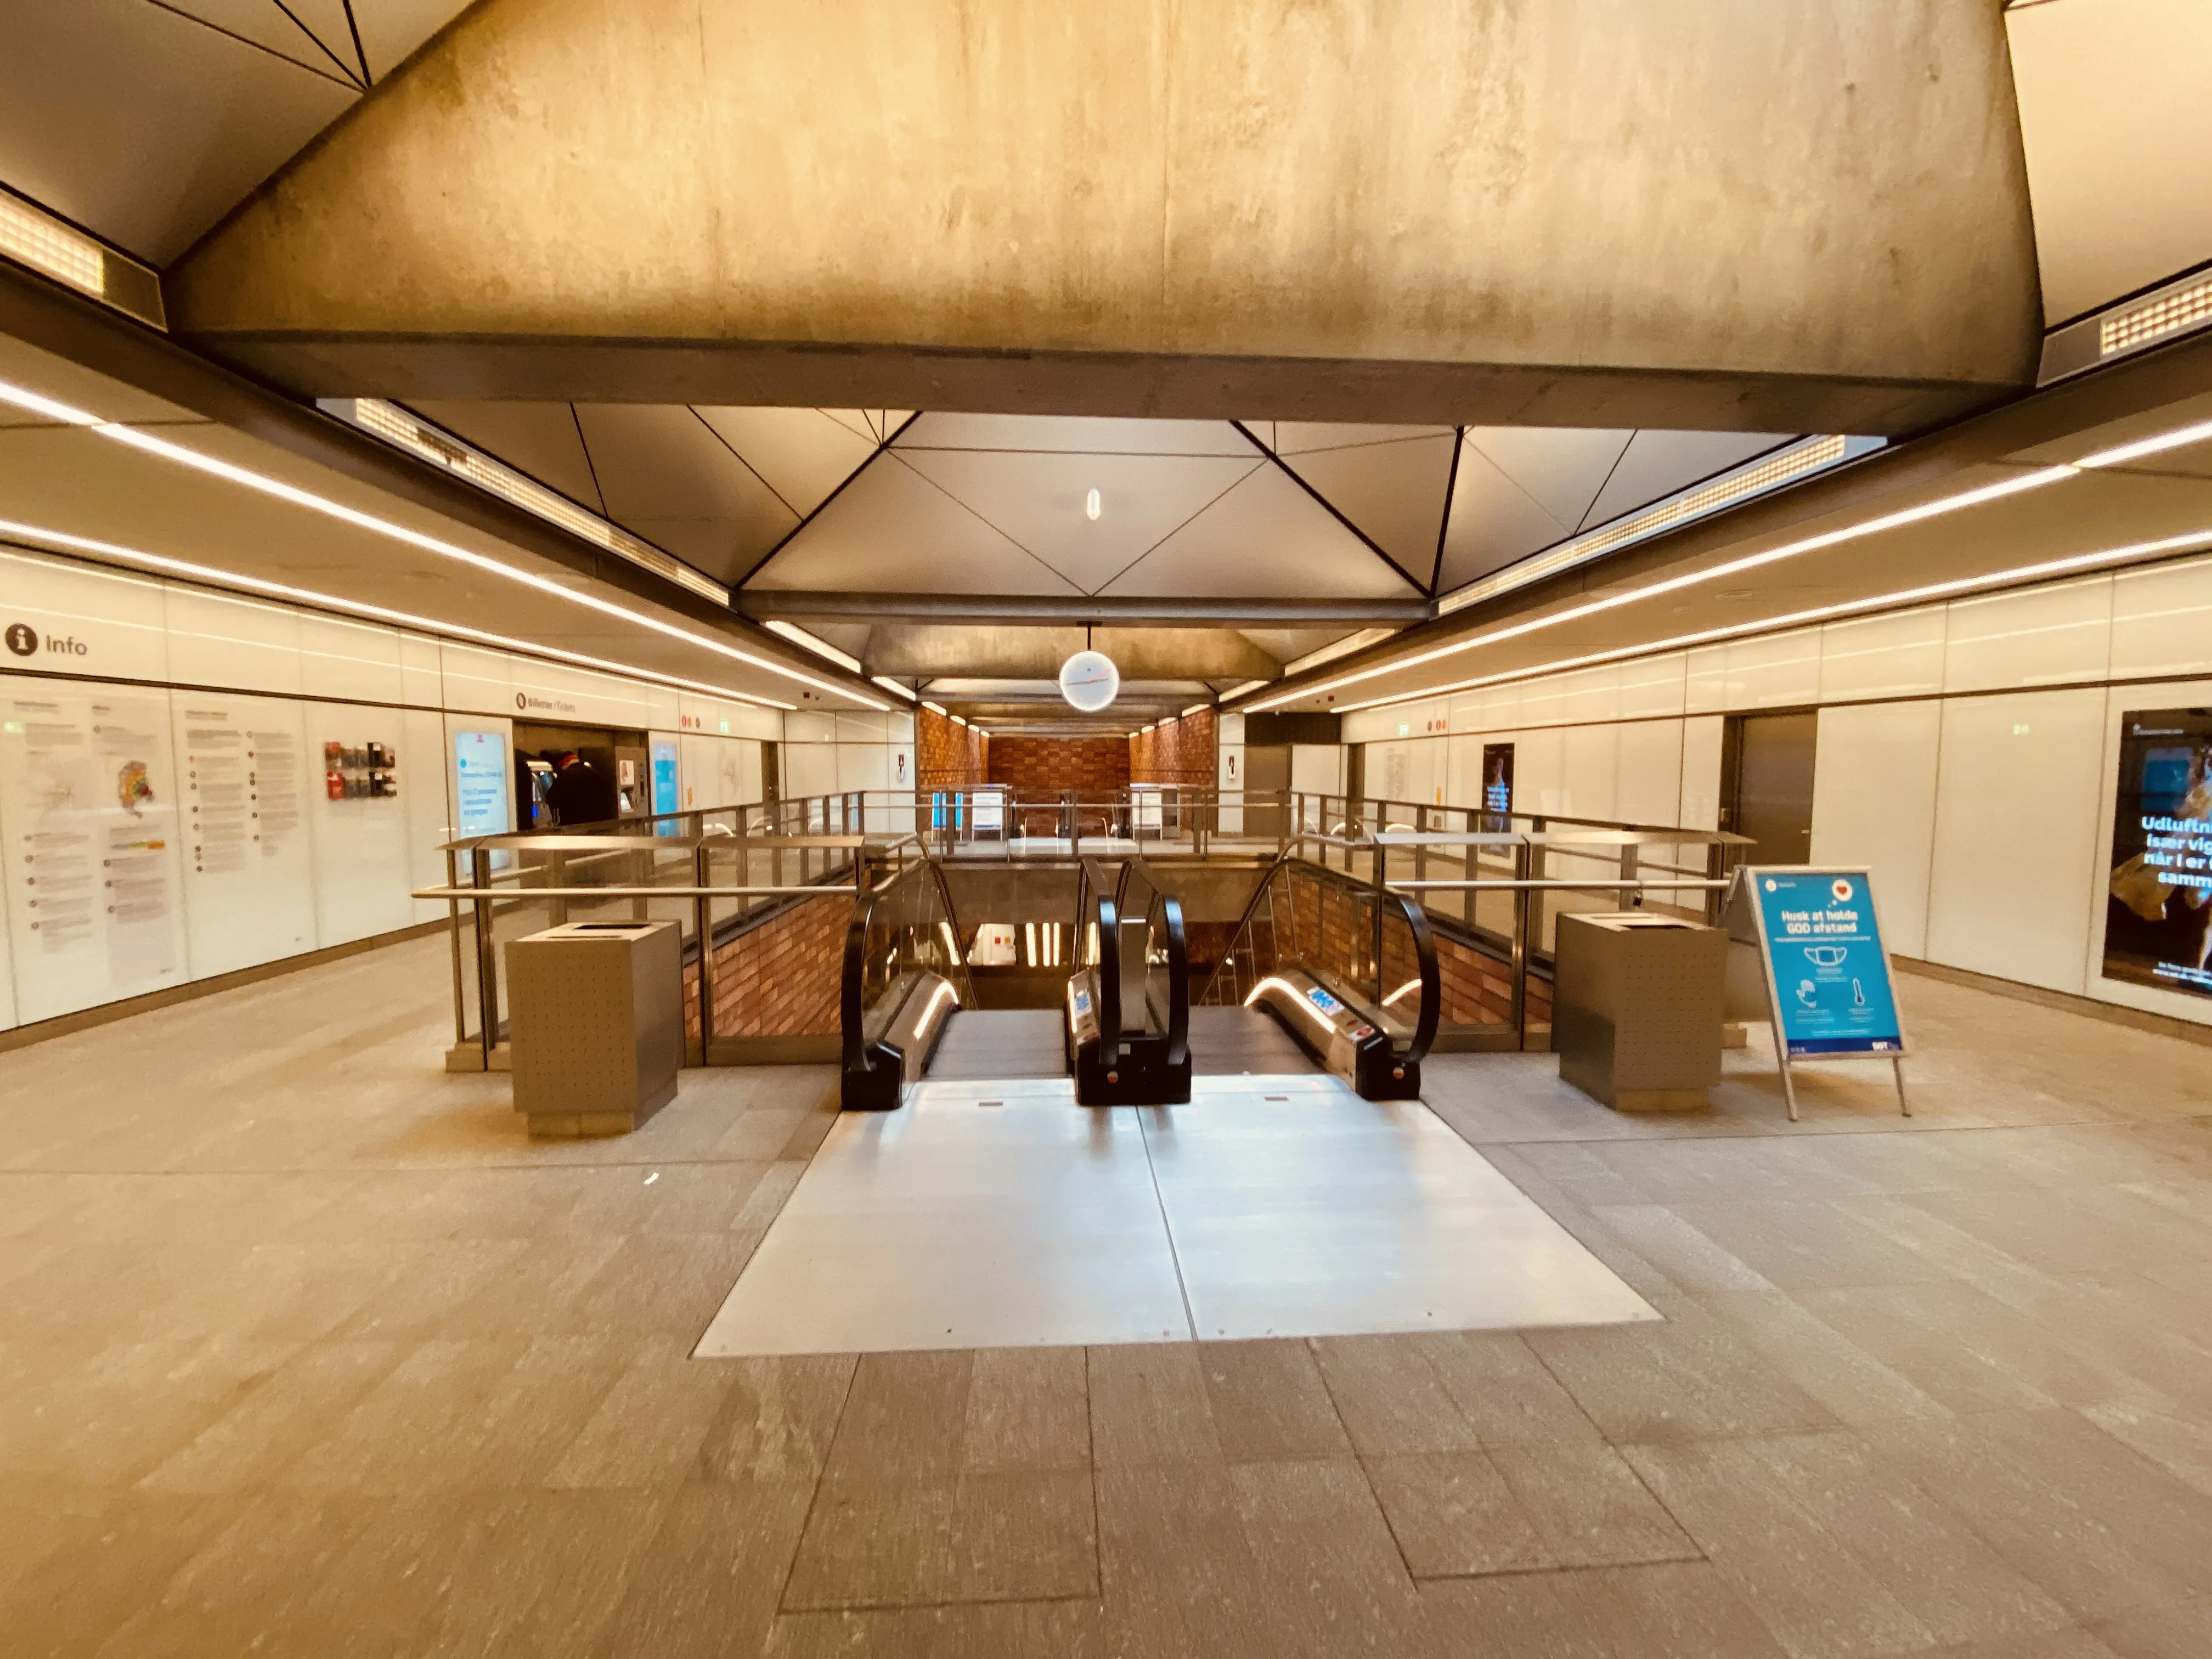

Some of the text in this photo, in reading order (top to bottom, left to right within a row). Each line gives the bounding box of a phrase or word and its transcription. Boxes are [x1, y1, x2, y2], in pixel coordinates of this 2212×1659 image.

[46, 634, 88, 656] Info
[2144, 851, 2174, 866] når
[2186, 857, 2207, 870] er
[1782, 910, 1809, 922] Husk
